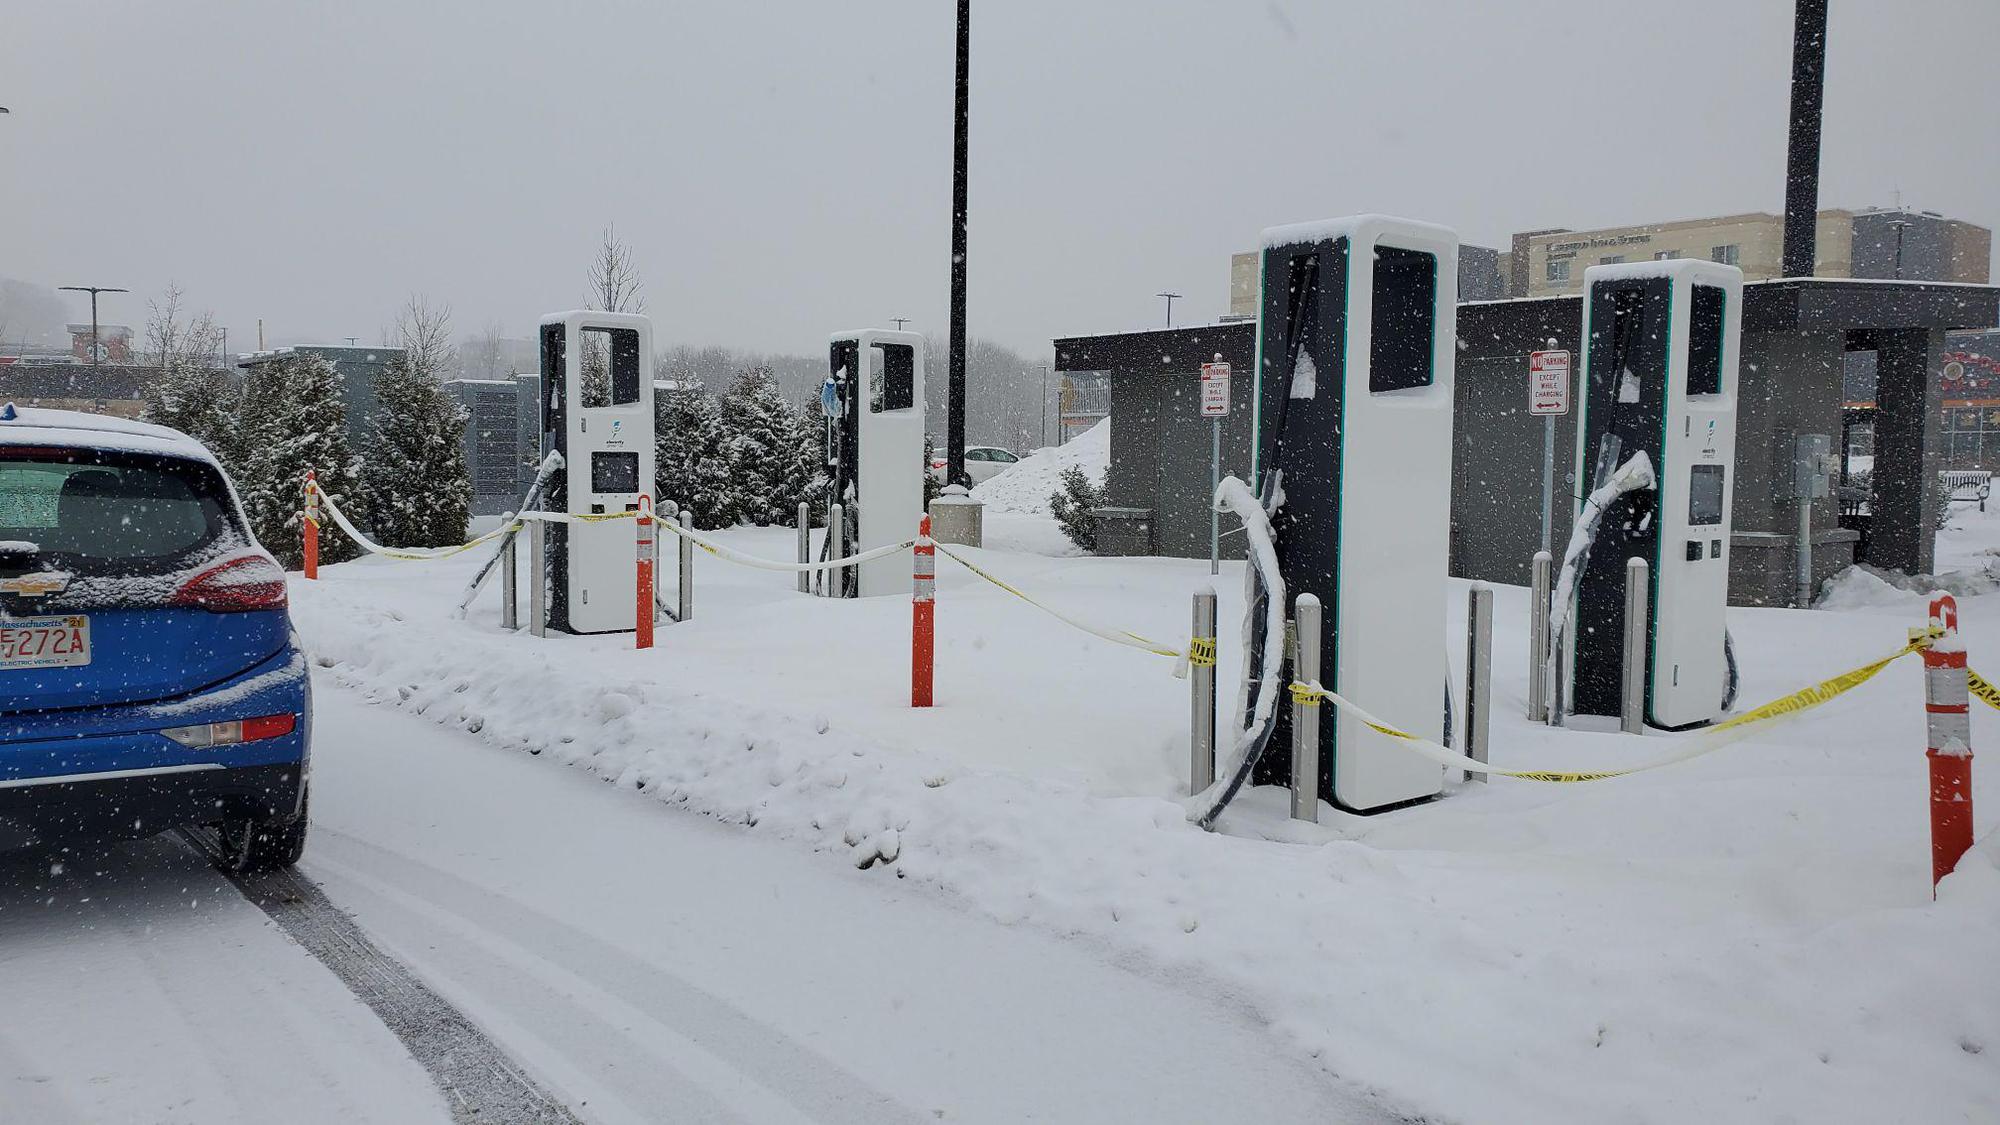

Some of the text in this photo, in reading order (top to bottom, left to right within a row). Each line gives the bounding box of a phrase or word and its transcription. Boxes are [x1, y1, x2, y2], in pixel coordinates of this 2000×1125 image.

[1544, 357, 1567, 366] PARKING
[1539, 373, 1561, 382] EXCEPT
[1535, 390, 1563, 398] CHARGING
